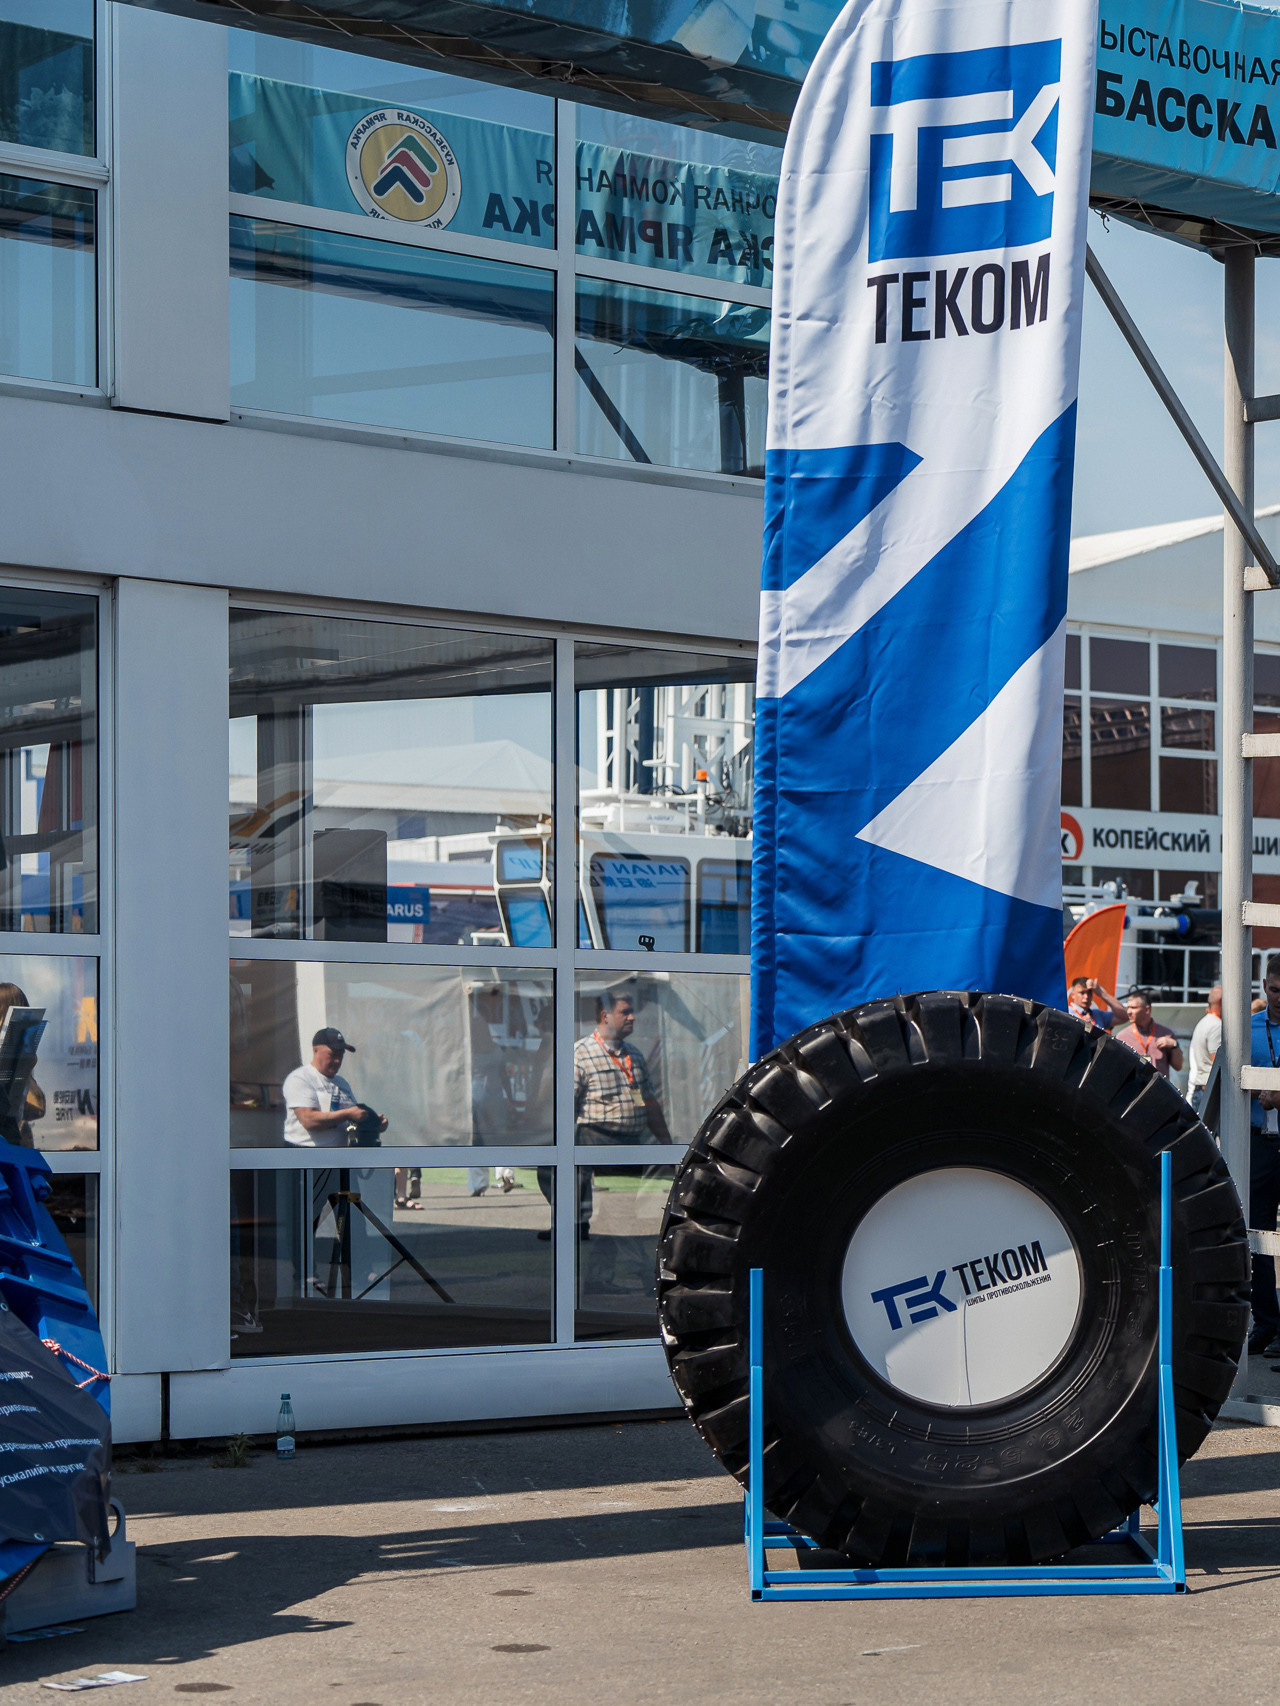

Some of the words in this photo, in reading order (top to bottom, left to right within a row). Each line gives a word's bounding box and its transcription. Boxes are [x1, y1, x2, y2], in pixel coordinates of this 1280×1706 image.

[1095, 69, 1277, 150] БАССКА
[866, 252, 1051, 345] TEKOM
[1092, 827, 1211, 854] КОПЕЙСКИЙ
[966, 1295, 986, 1307] ШИПЫ
[986, 1273, 1052, 1301] ПРОТИВОСКОЛЬЖЕНИЯ
[0, 1442, 42, 1453] азрешение
[42, 1440, 56, 1450] на
